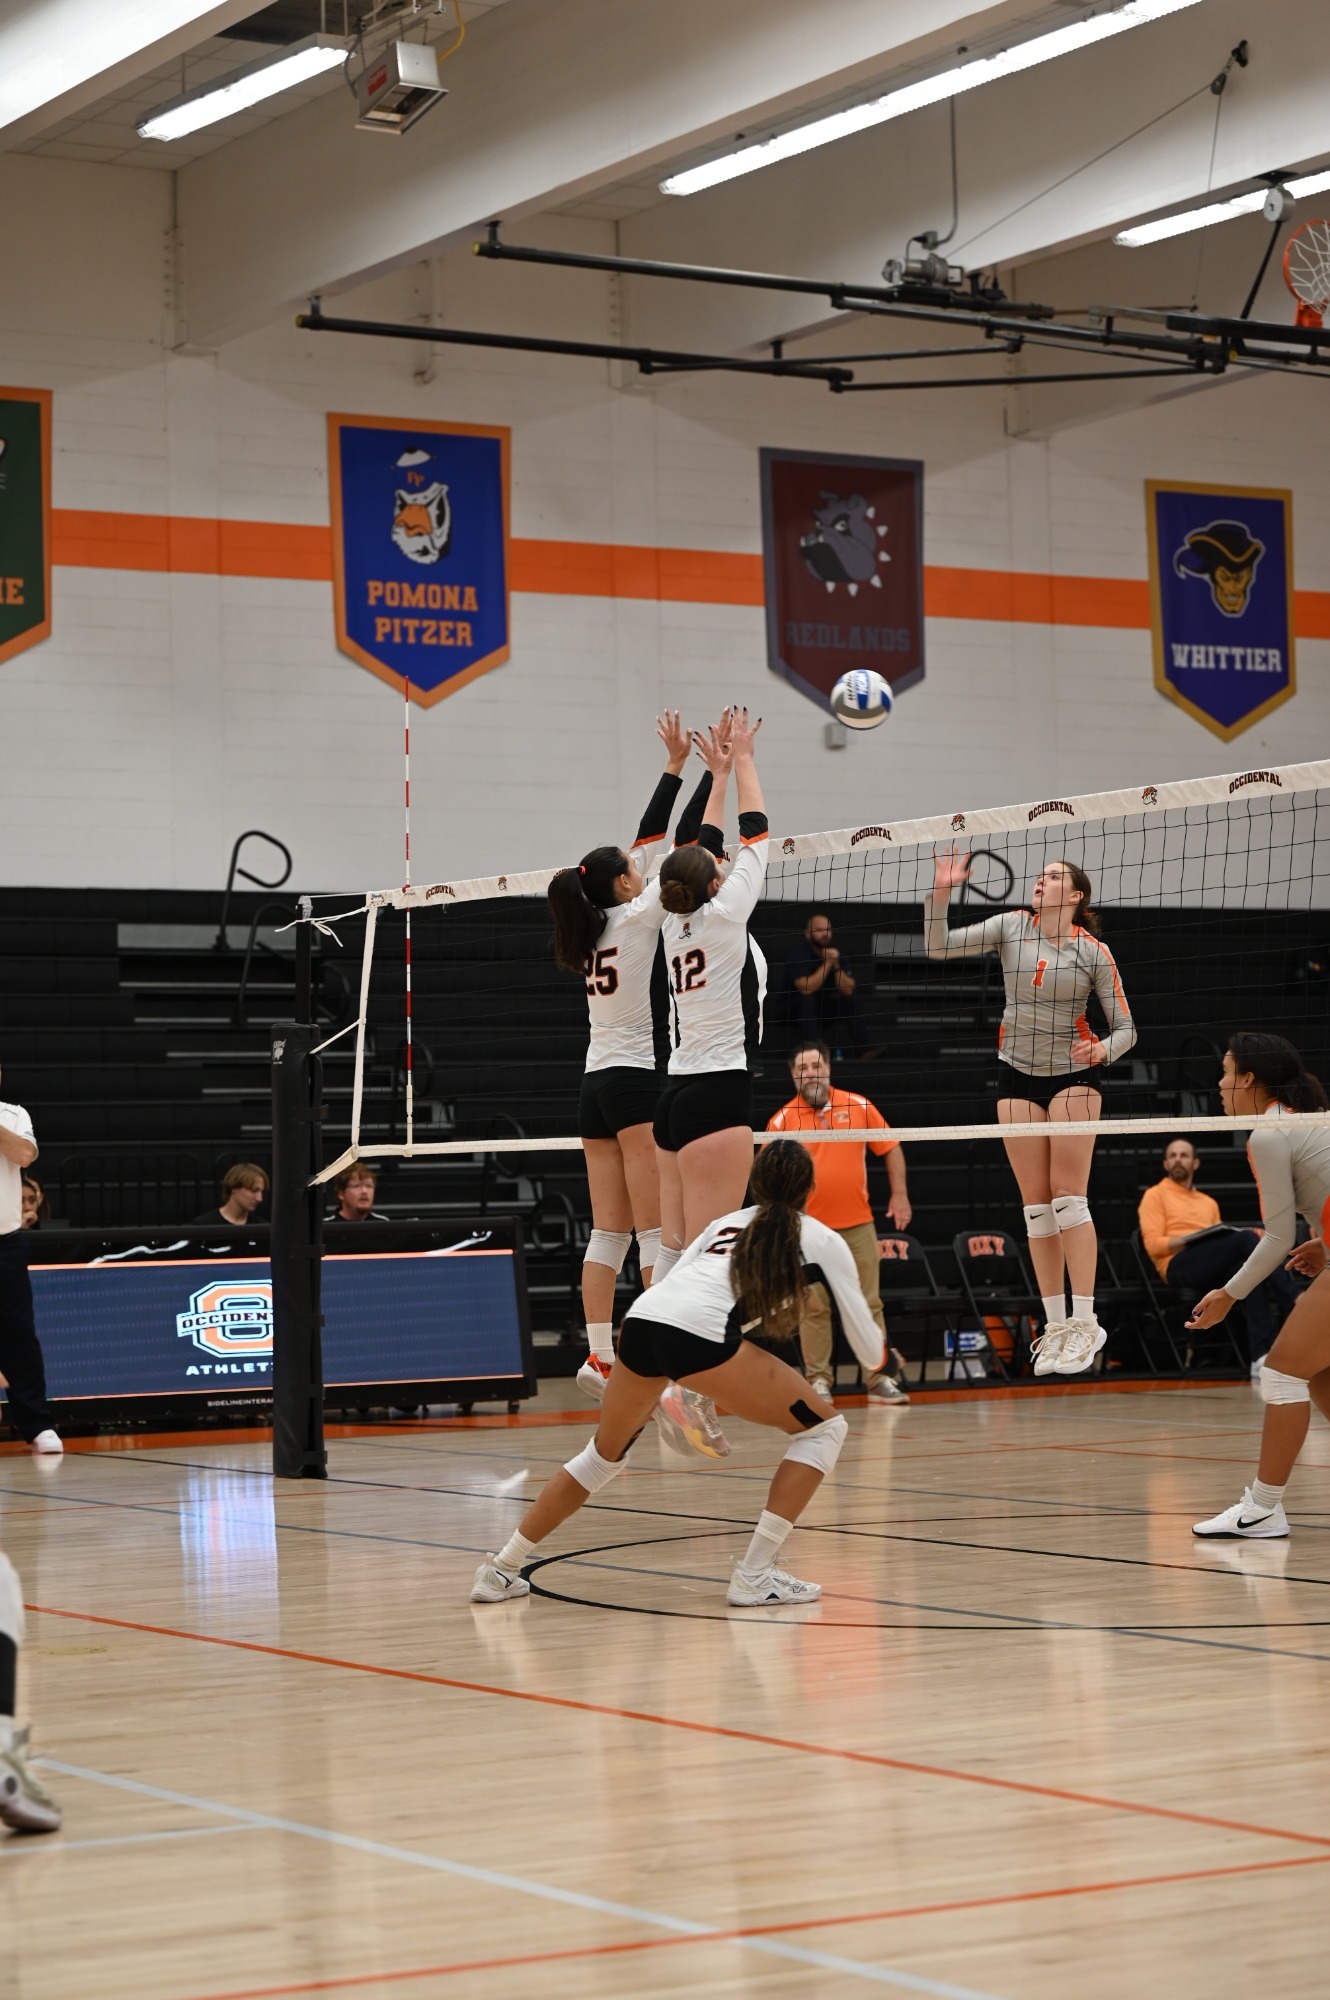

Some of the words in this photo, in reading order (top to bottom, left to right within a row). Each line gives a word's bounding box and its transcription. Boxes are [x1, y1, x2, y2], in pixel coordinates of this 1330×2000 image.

[0, 577, 24, 605] E
[367, 580, 479, 612] POMONA
[375, 617, 473, 647] PITZER
[786, 621, 911, 652] REDLANDS
[1171, 643, 1282, 672] WHITTIER
[1229, 771, 1282, 794] OCCIDENTAL
[1028, 801, 1075, 822] OCCIDENTAL
[851, 827, 892, 846] OCCIDENTAL
[671, 948, 707, 995] 12
[1031, 959, 1049, 989] 1
[705, 1226, 748, 1255] 2
[968, 1235, 1005, 1258] OXY
[182, 1312, 273, 1329] OCCIDEN
[186, 1361, 273, 1376] ATHLET
[207, 1397, 273, 1407] SIDELINEINTERA
